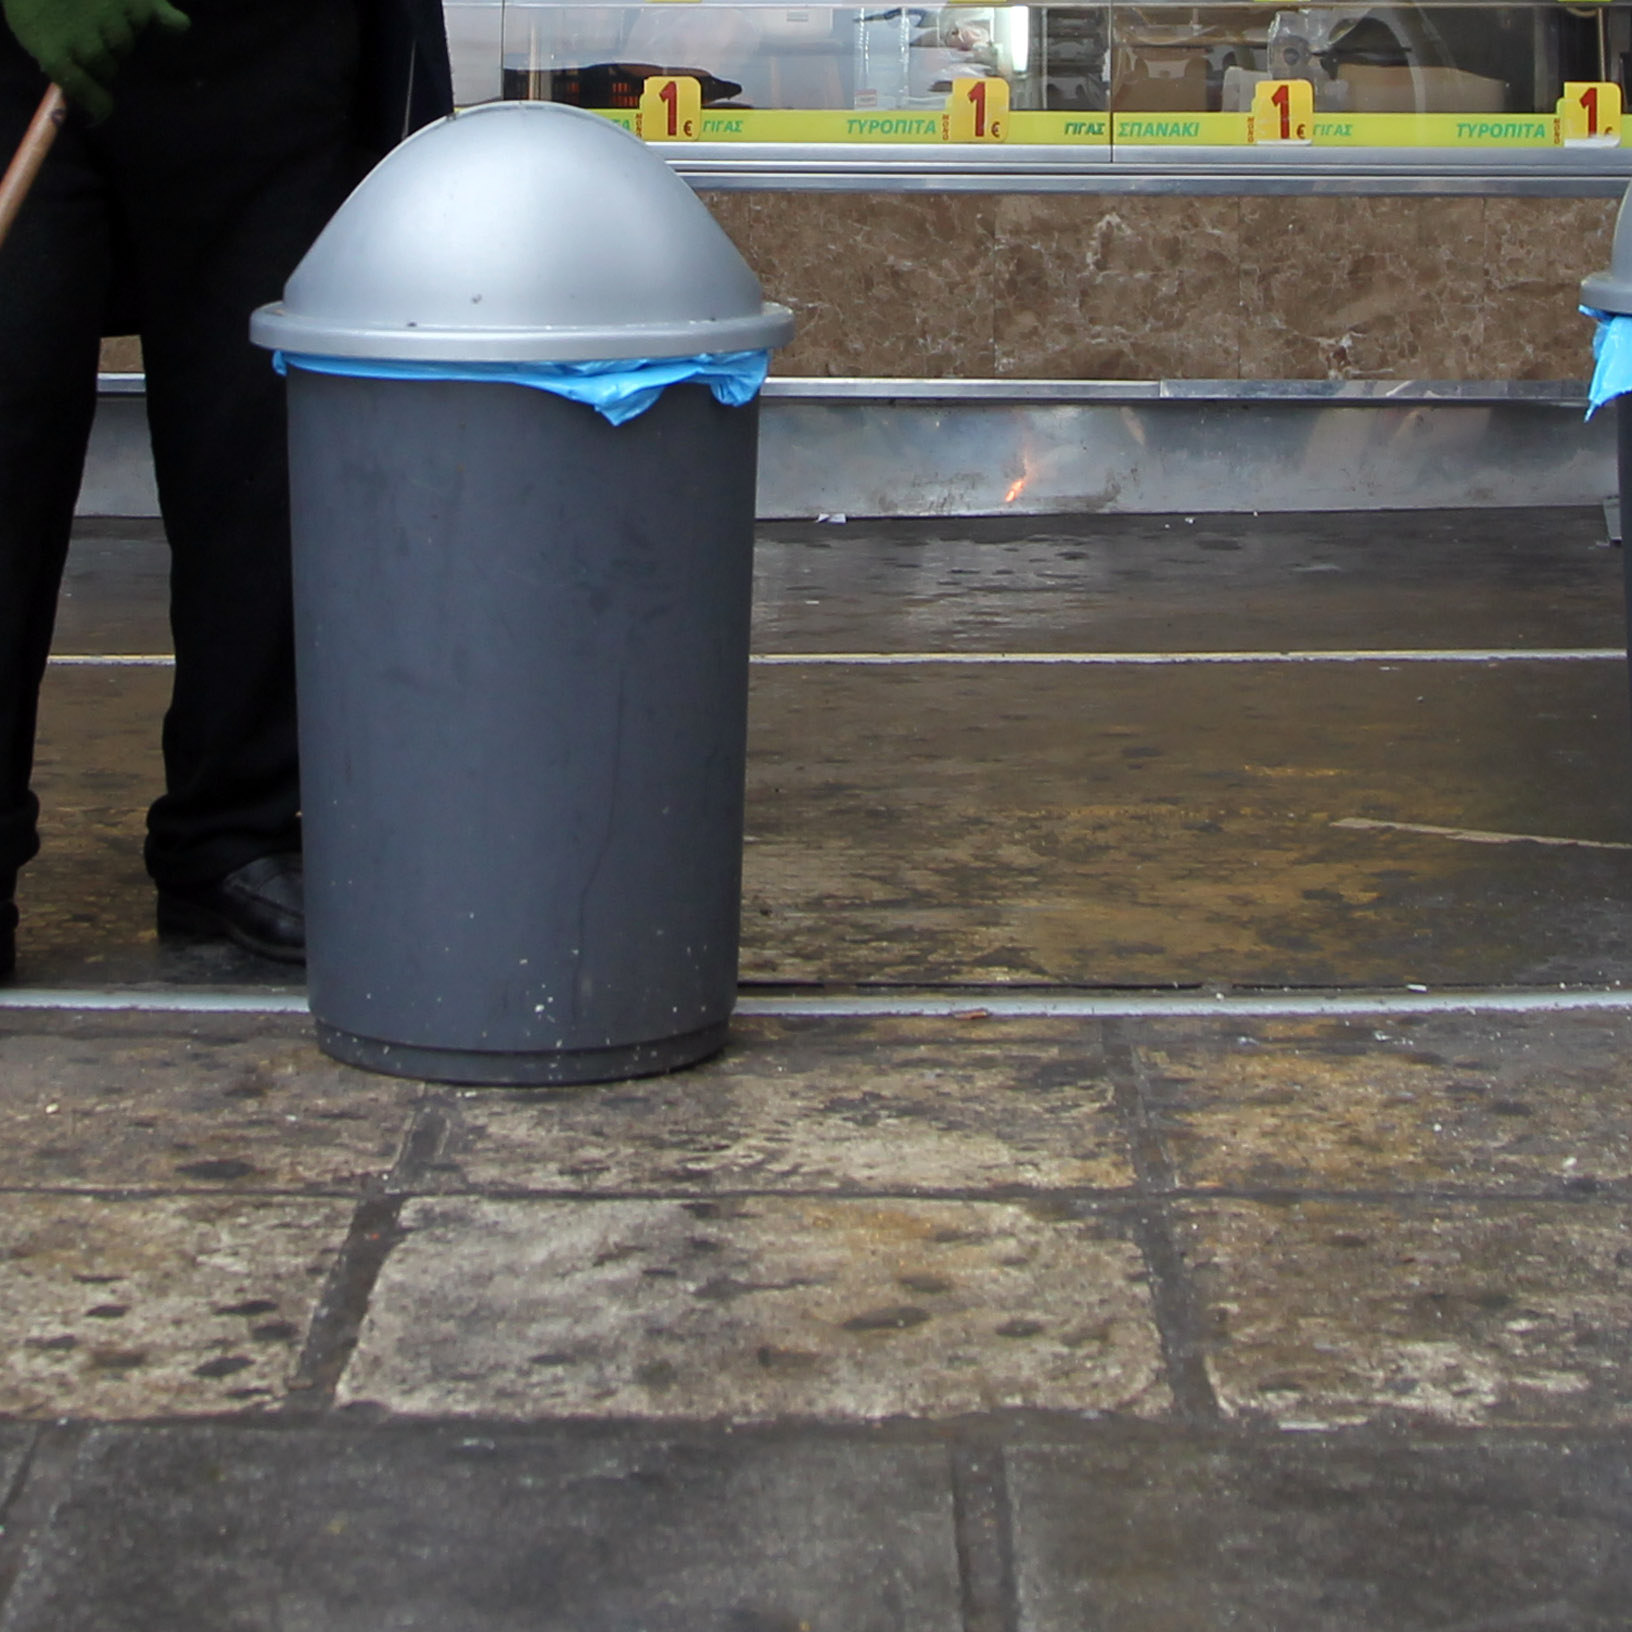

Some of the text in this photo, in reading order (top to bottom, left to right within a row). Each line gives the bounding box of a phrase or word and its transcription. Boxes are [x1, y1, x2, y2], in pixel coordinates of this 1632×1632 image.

[703, 119, 744, 133] ΓΙΓΑΣ
[847, 119, 937, 134] ΤΥΡΟΠΙΤΑ
[1064, 123, 1106, 135] ΓΙΓΑΣ
[1119, 123, 1199, 137] ΣΠΑΝΑΚΙ
[1313, 124, 1353, 136] ΓΙΓΑΣ
[1456, 123, 1546, 138] ΤΥΡΟΠΙΤΑ
